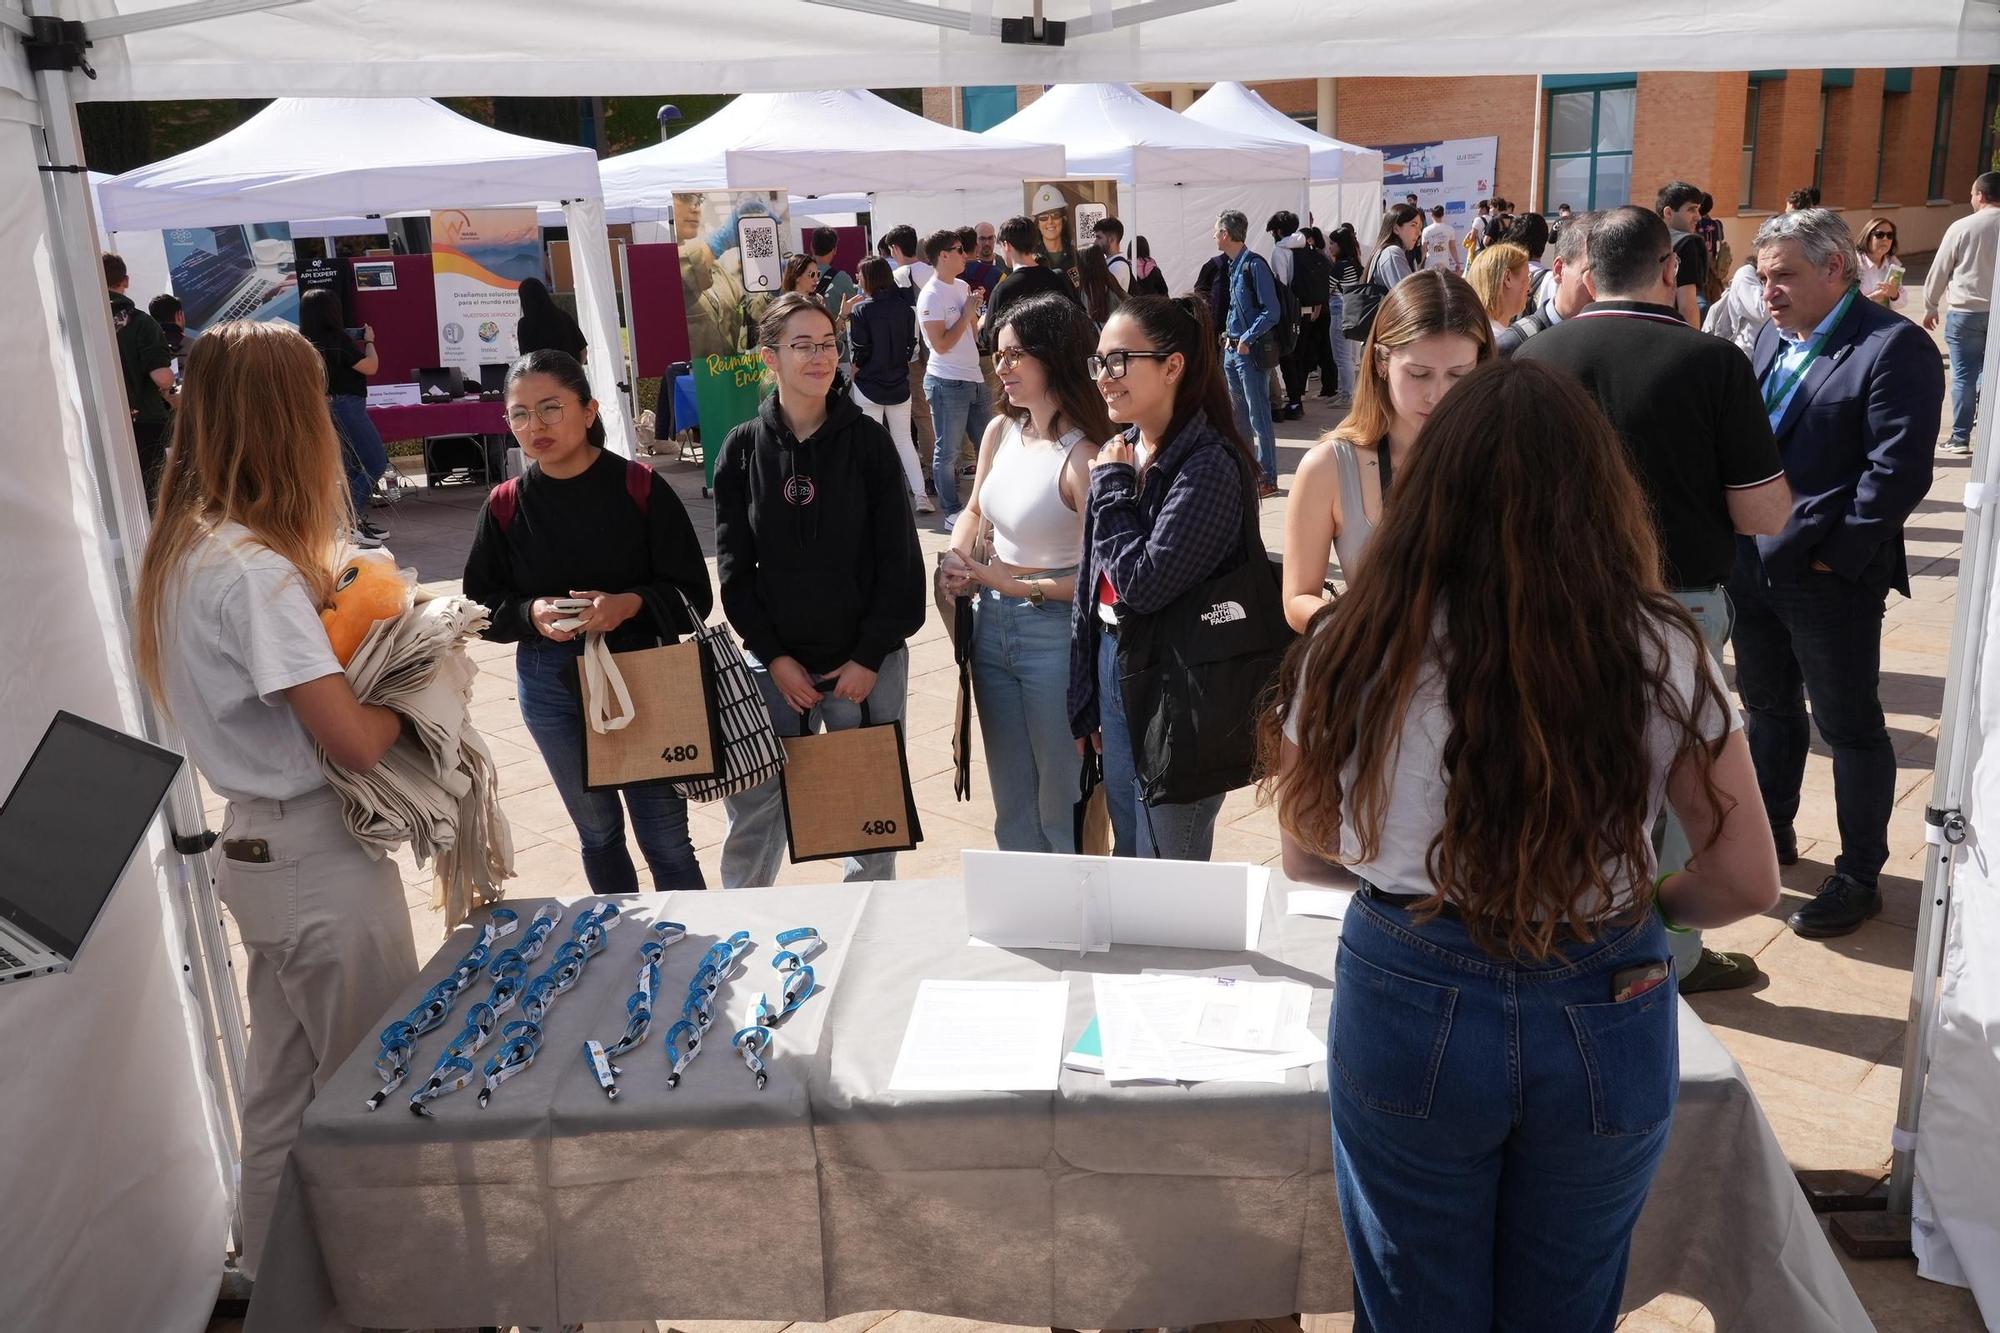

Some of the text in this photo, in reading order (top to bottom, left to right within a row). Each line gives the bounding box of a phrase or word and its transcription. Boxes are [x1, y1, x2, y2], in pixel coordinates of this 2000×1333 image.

[313, 270, 338, 278] EXPERT
[1211, 602, 1229, 611] THE
[1201, 609, 1230, 621] NORTH
[1210, 614, 1232, 626] FACE
[661, 744, 698, 763] 480
[862, 820, 896, 835] 480
